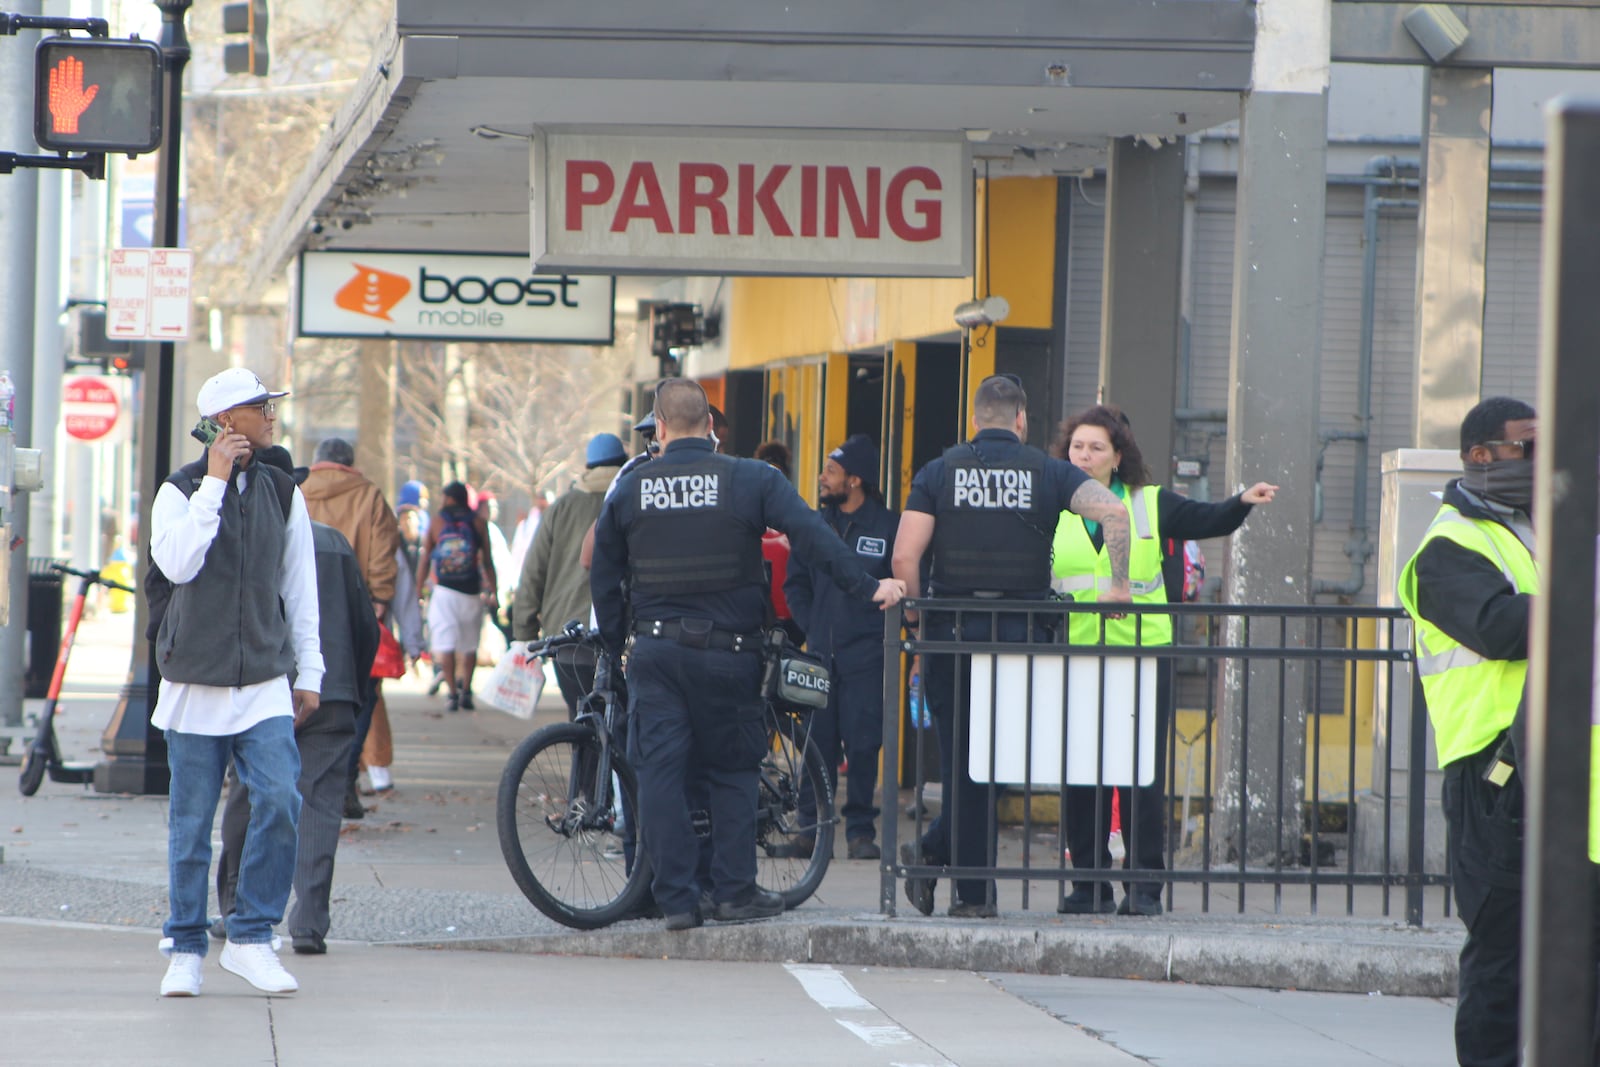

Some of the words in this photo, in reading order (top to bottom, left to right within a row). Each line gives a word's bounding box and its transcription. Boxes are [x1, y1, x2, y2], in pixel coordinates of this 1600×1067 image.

[565, 160, 943, 242] PARKING
[419, 267, 579, 307] boost
[418, 308, 504, 327] mobile
[87, 388, 112, 401] NOT
[640, 474, 718, 494] DAYTON
[954, 468, 1032, 488] DAYTON
[640, 490, 718, 510] POLICE
[954, 487, 1032, 509] POLICE
[787, 670, 831, 693] POLICE
